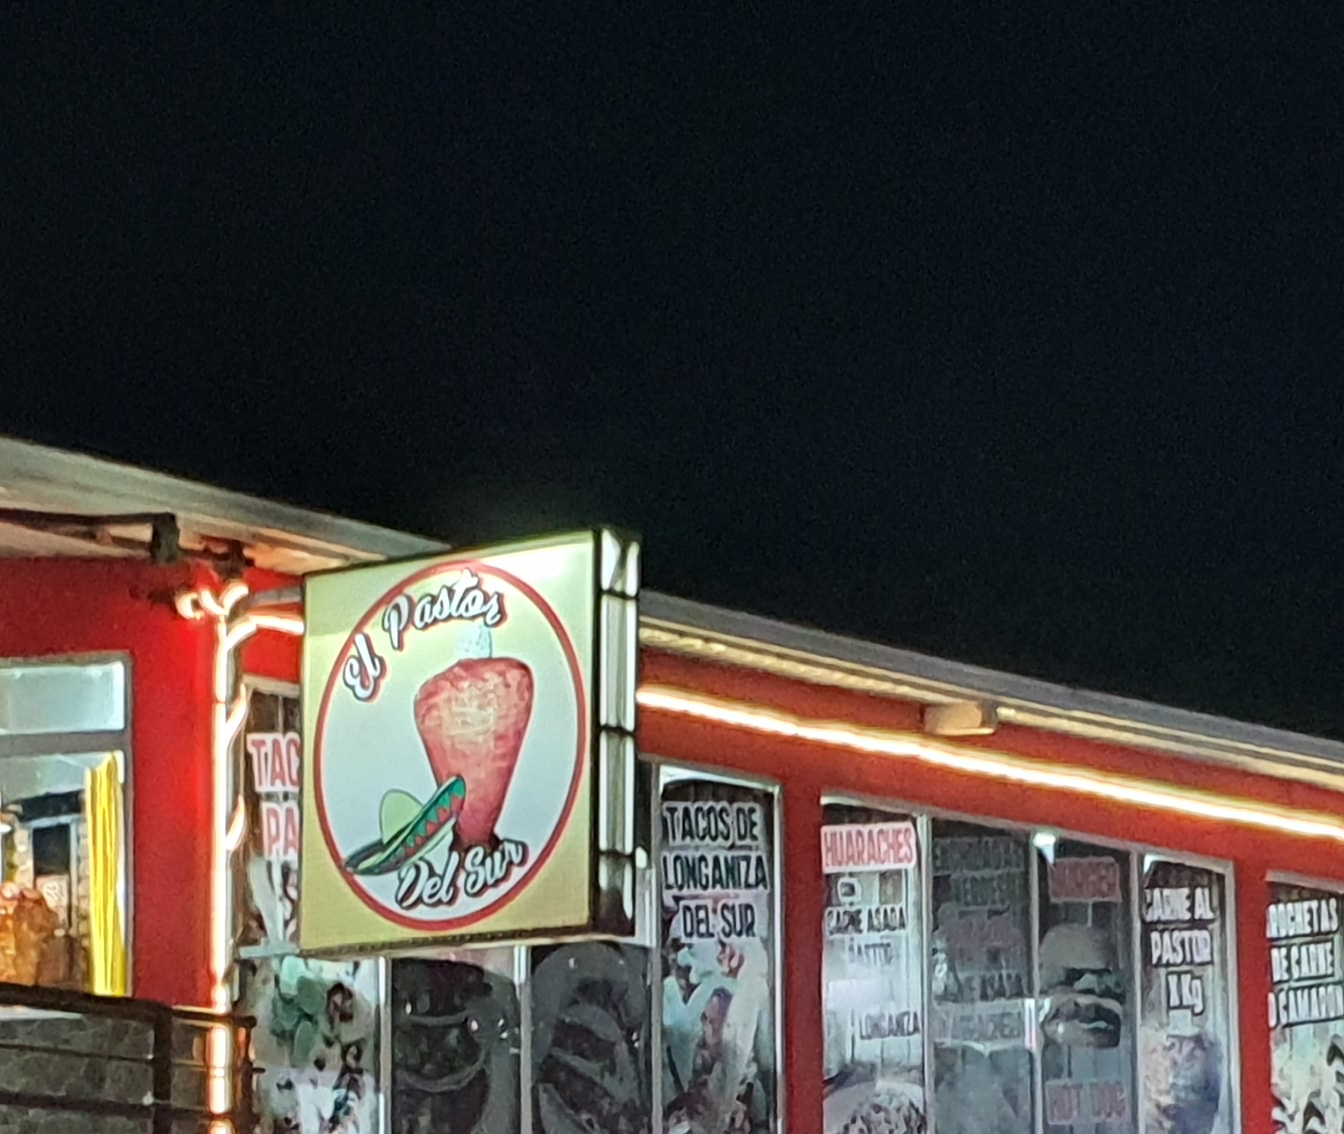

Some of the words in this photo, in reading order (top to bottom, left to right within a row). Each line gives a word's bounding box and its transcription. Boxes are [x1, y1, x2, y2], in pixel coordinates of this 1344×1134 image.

[343, 631, 383, 700] El
[383, 567, 504, 650] Pastor
[665, 806, 731, 842] TACOS
[735, 806, 759, 842] DE
[824, 828, 914, 867] HUARACHES
[396, 851, 459, 910] Del
[464, 839, 527, 897] Sur
[662, 854, 768, 892] LONGANIZA
[682, 904, 715, 938] DEL
[720, 903, 756, 938] SUR
[1194, 887, 1216, 921] AL
[1150, 929, 1212, 965] PASTOR
[1291, 942, 1334, 980] CARNE
